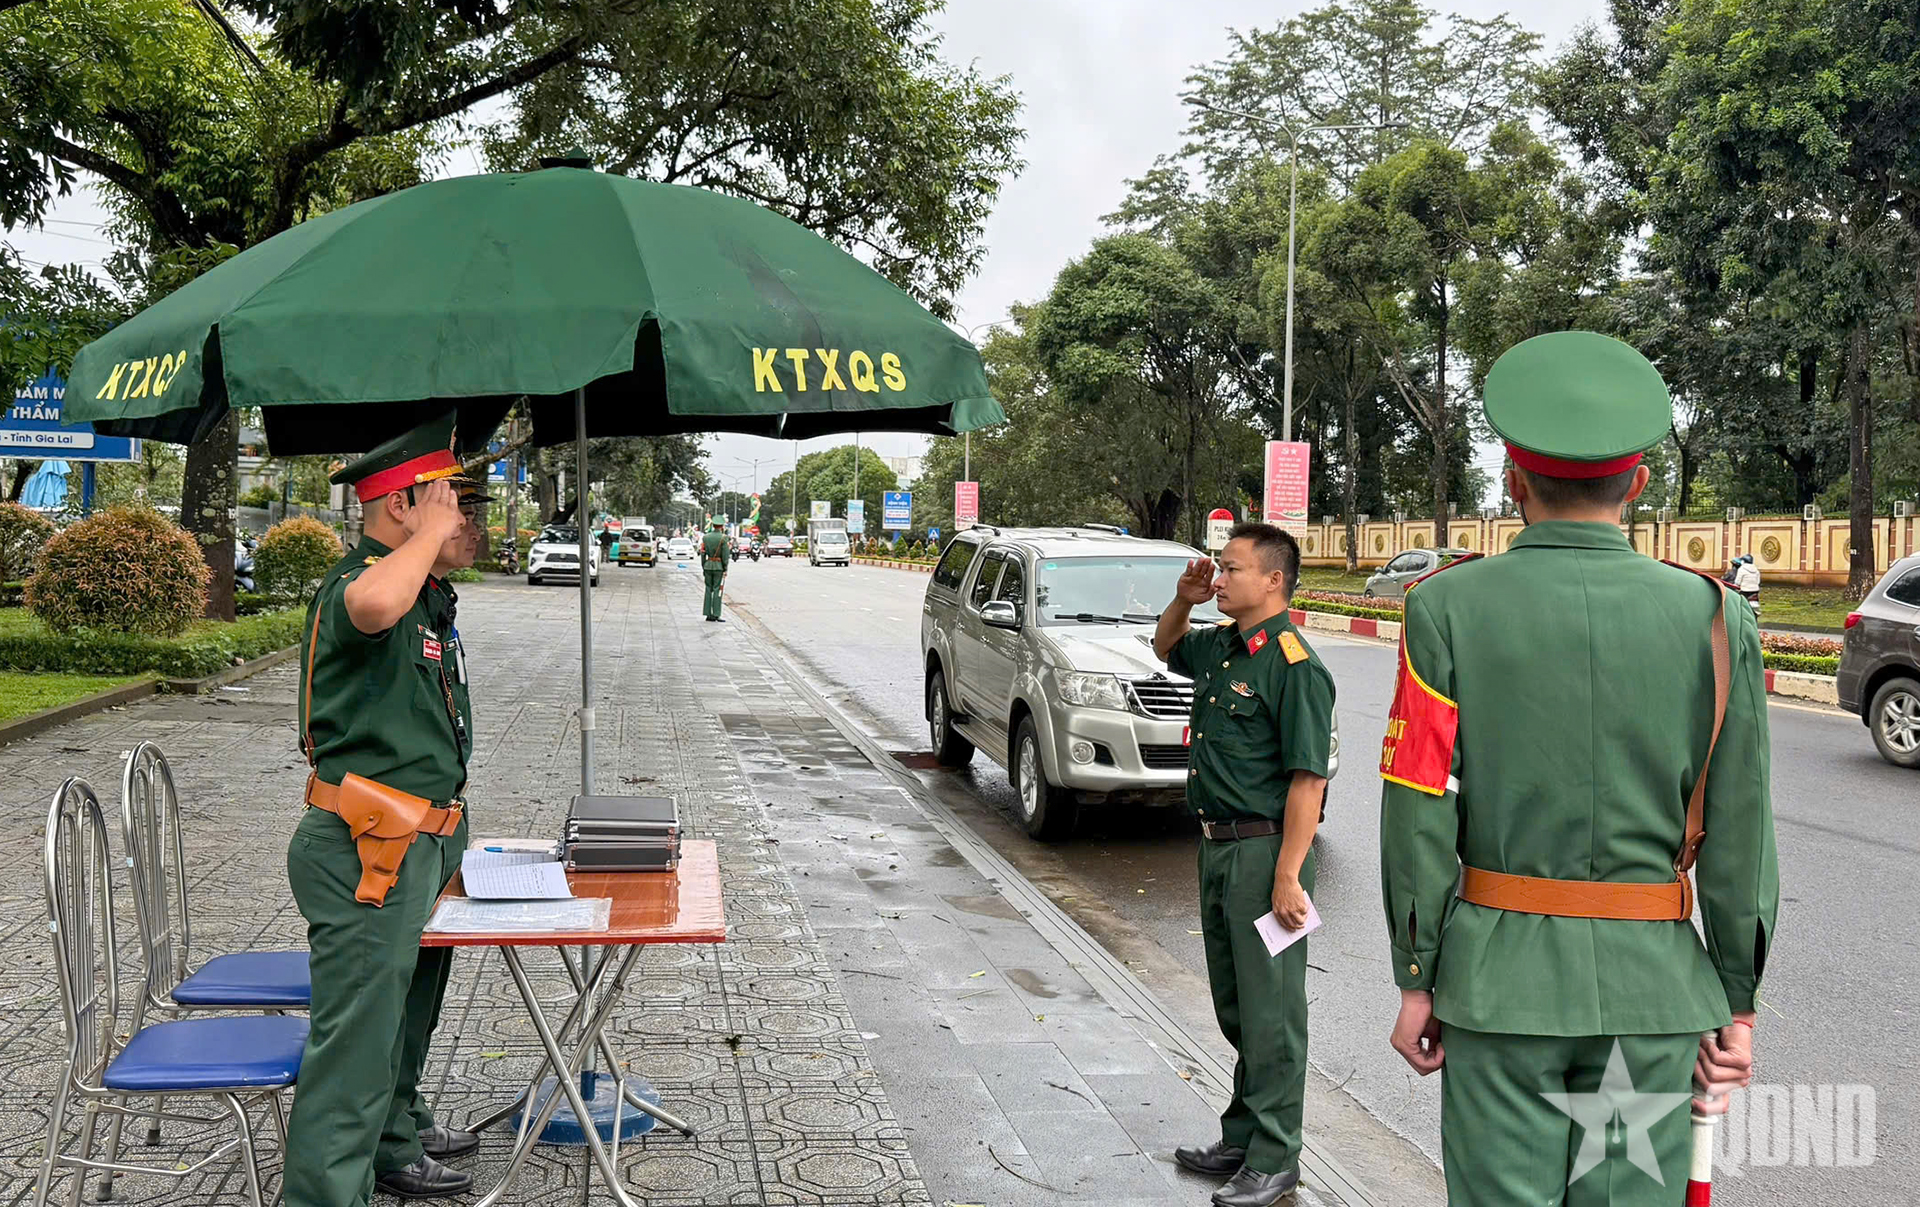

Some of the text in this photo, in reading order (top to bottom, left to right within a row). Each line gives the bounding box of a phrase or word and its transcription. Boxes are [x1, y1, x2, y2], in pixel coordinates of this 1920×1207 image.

[752, 347, 906, 393] KTXQS
[11, 433, 32, 443] Tỉnh
[35, 434, 54, 443] Gia
[58, 435, 73, 444] Lai
[1385, 715, 1407, 740] OÁT
